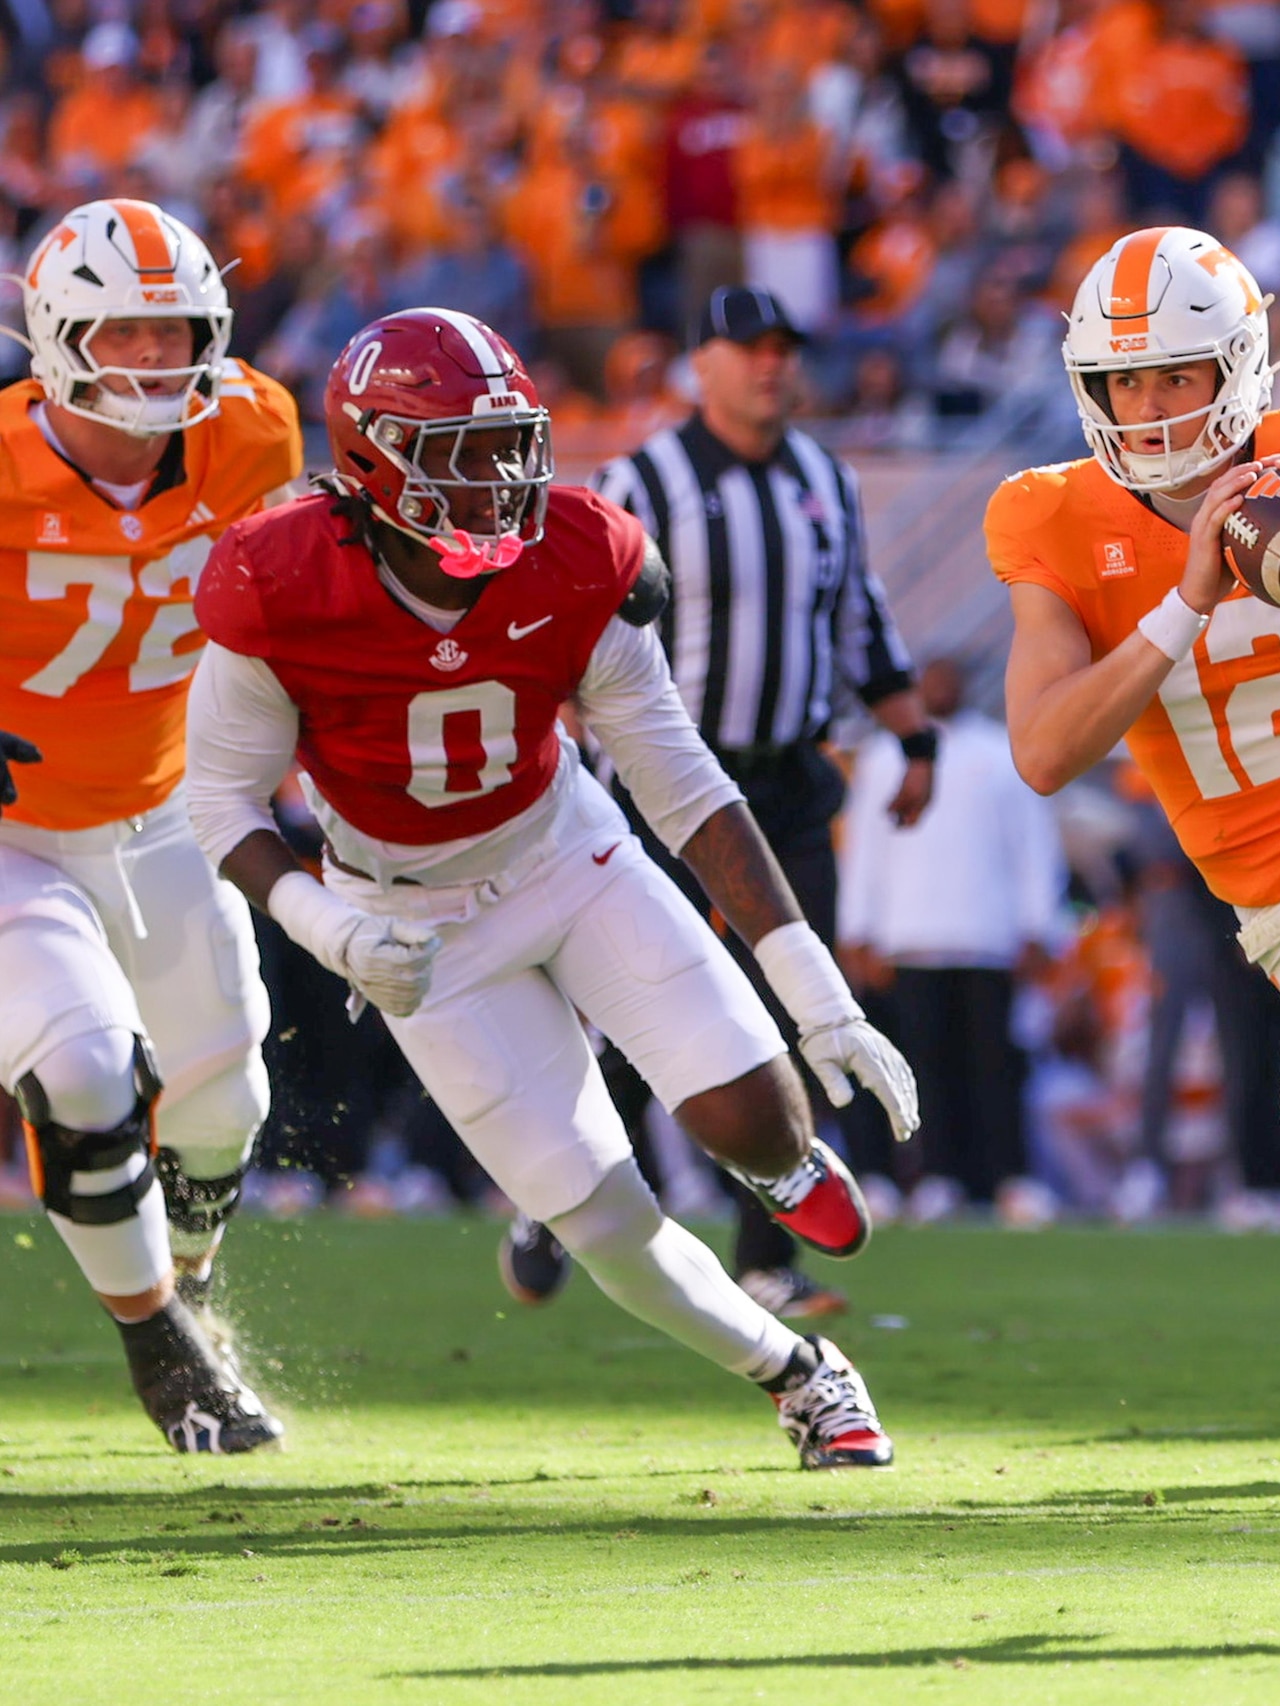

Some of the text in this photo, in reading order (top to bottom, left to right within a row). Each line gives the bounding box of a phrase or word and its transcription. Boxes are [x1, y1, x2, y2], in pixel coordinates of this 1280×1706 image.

[348, 341, 382, 396] 0
[20, 534, 214, 698] 72
[406, 680, 518, 809] 0
